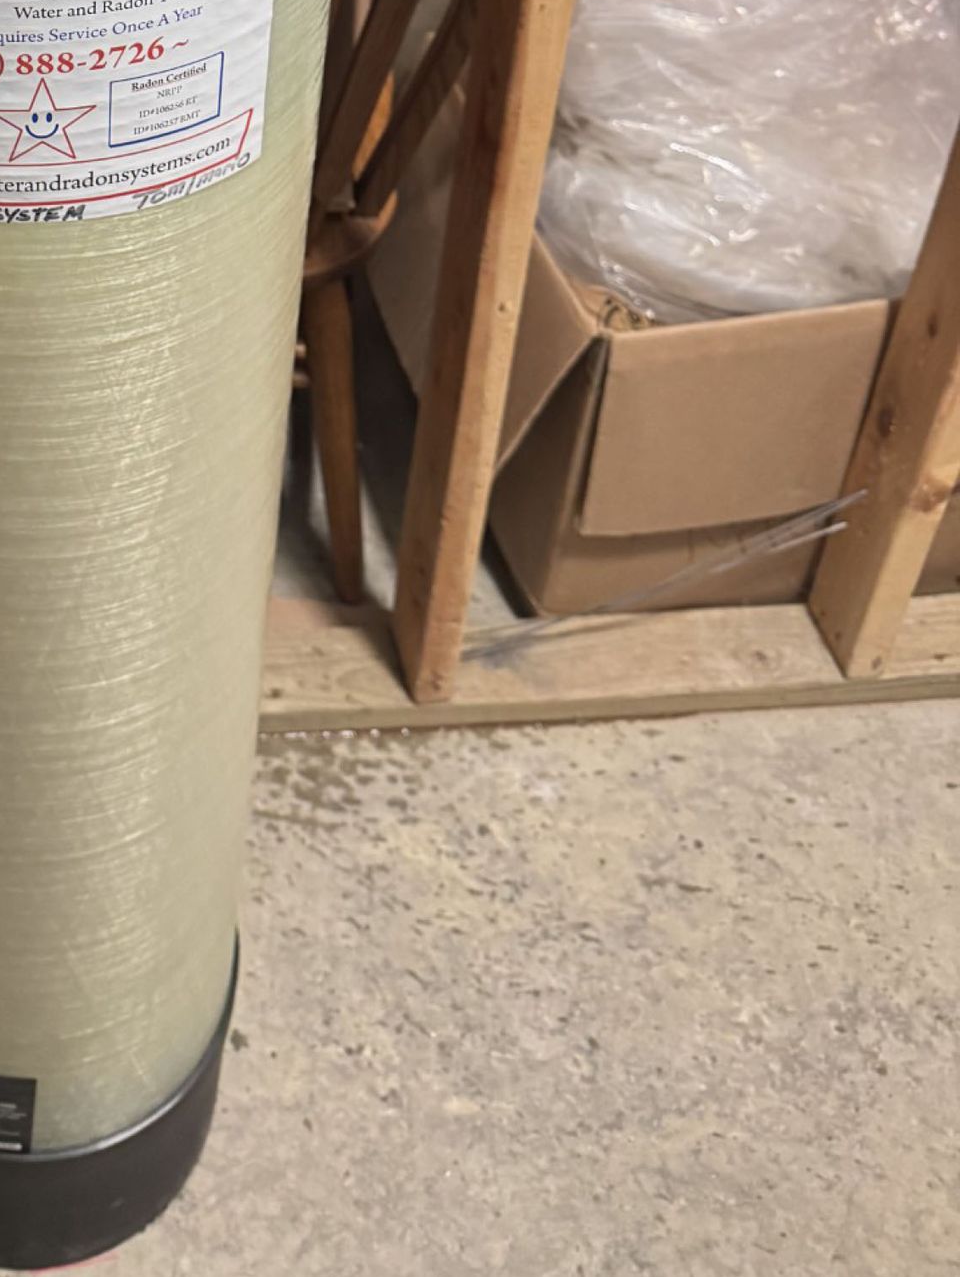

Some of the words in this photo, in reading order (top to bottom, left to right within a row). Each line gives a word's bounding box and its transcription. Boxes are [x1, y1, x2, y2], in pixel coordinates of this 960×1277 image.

[13, 6, 64, 20] Water
[67, 1, 97, 17] and
[48, 27, 107, 42] Service
[112, 20, 154, 35] Once
[157, 16, 169, 27] A
[172, 5, 203, 23] Year
[16, 36, 164, 76] 888-2726
[131, 78, 164, 93] Radon
[166, 62, 207, 84] Certified
